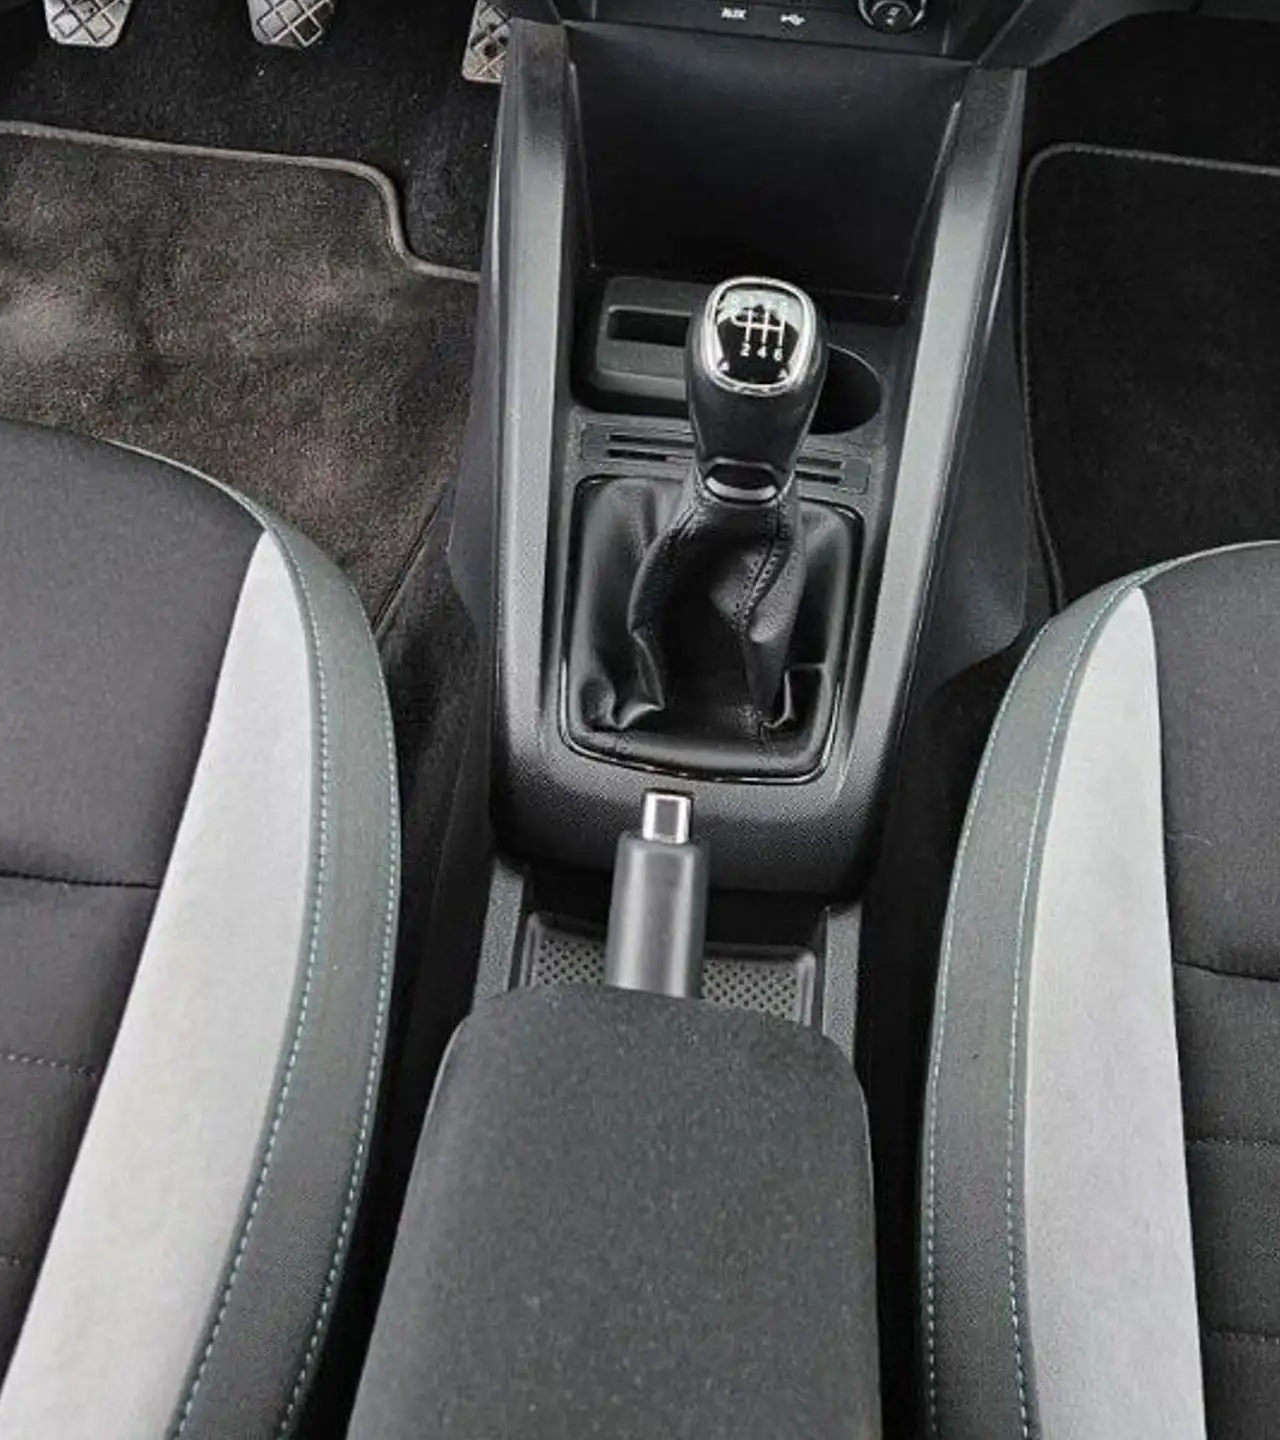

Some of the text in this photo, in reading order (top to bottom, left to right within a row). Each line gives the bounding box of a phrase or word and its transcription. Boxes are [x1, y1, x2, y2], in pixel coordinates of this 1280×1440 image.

[740, 341, 783, 361] 2 4 6
